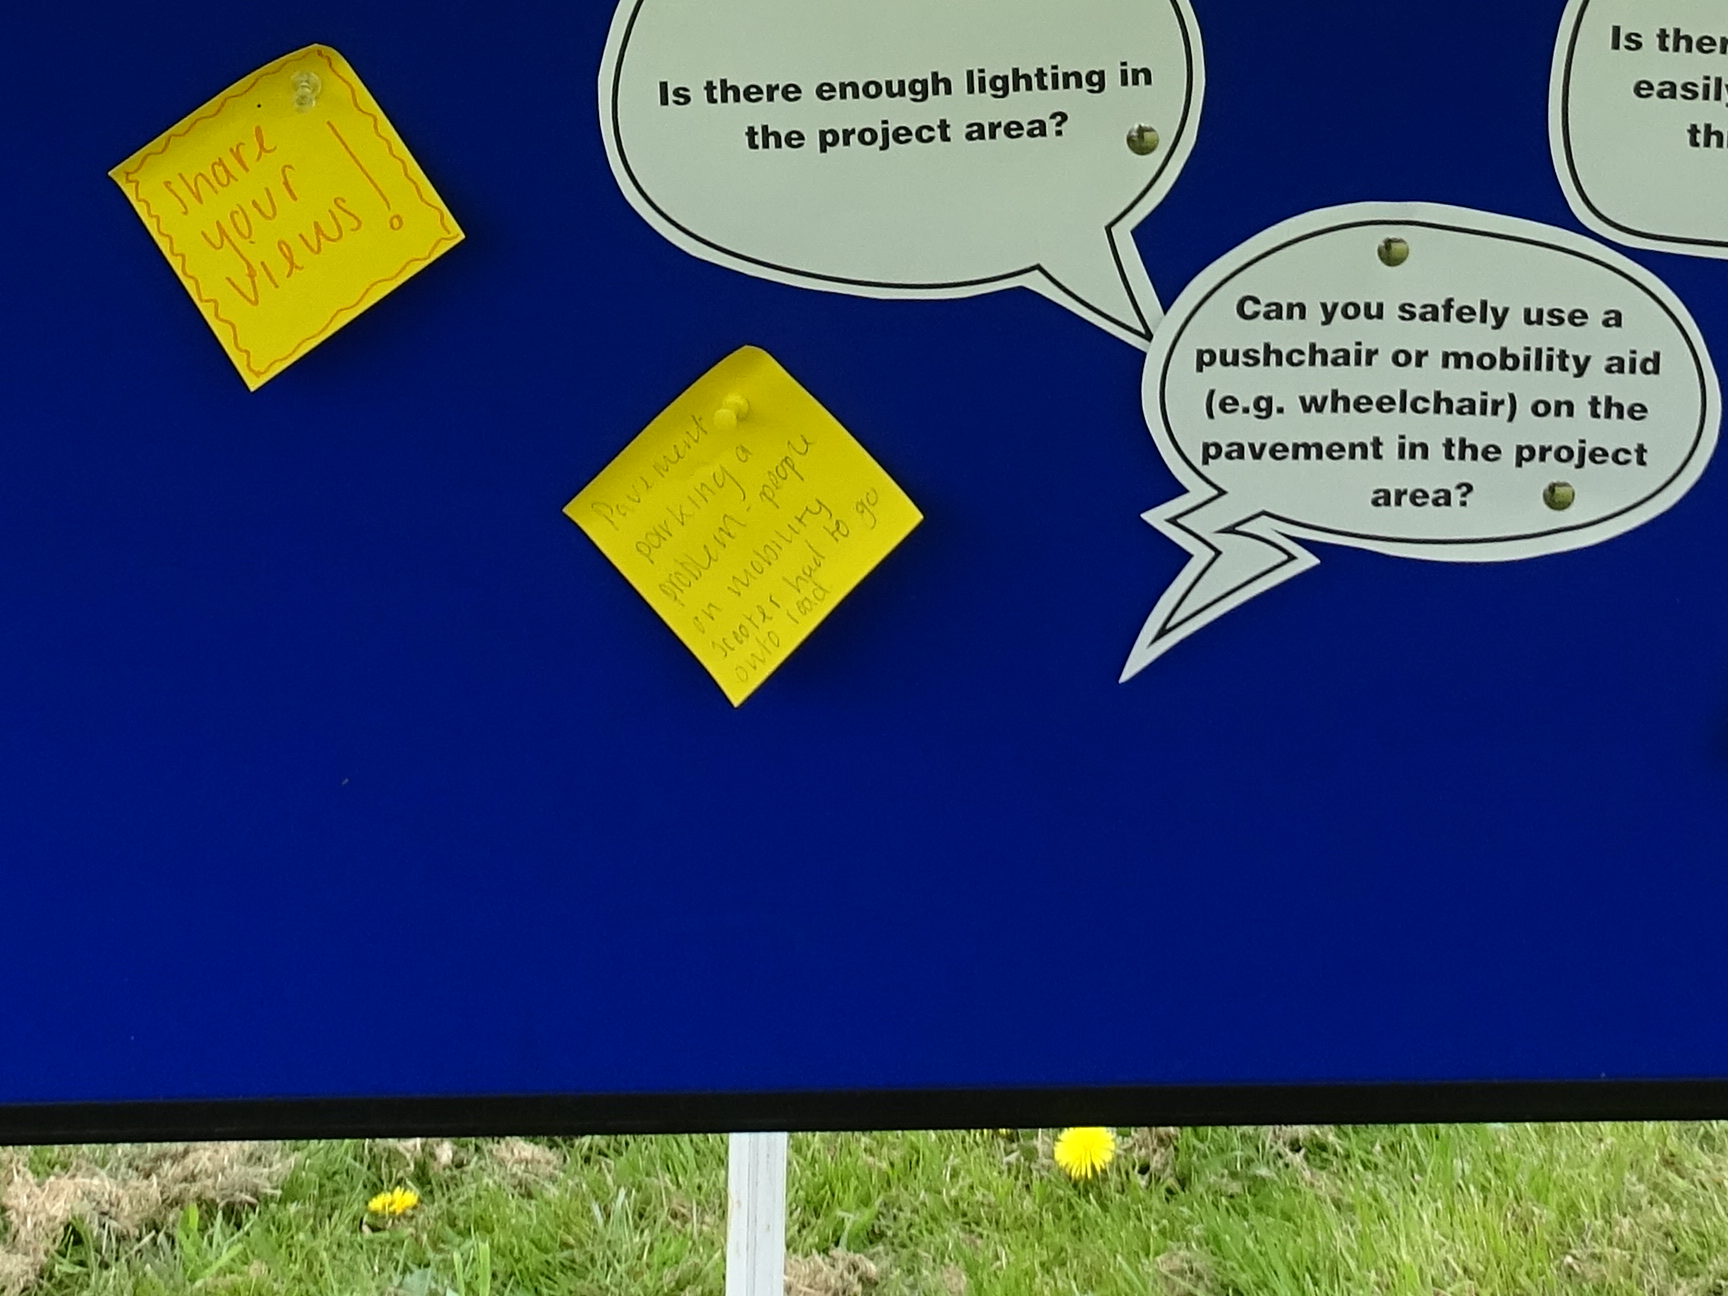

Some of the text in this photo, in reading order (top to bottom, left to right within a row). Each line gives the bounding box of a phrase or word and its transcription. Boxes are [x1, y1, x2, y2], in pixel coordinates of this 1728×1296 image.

[659, 61, 1153, 107] Is there enough lighting in
[744, 111, 1069, 154] the project area?
[201, 164, 295, 277] your
